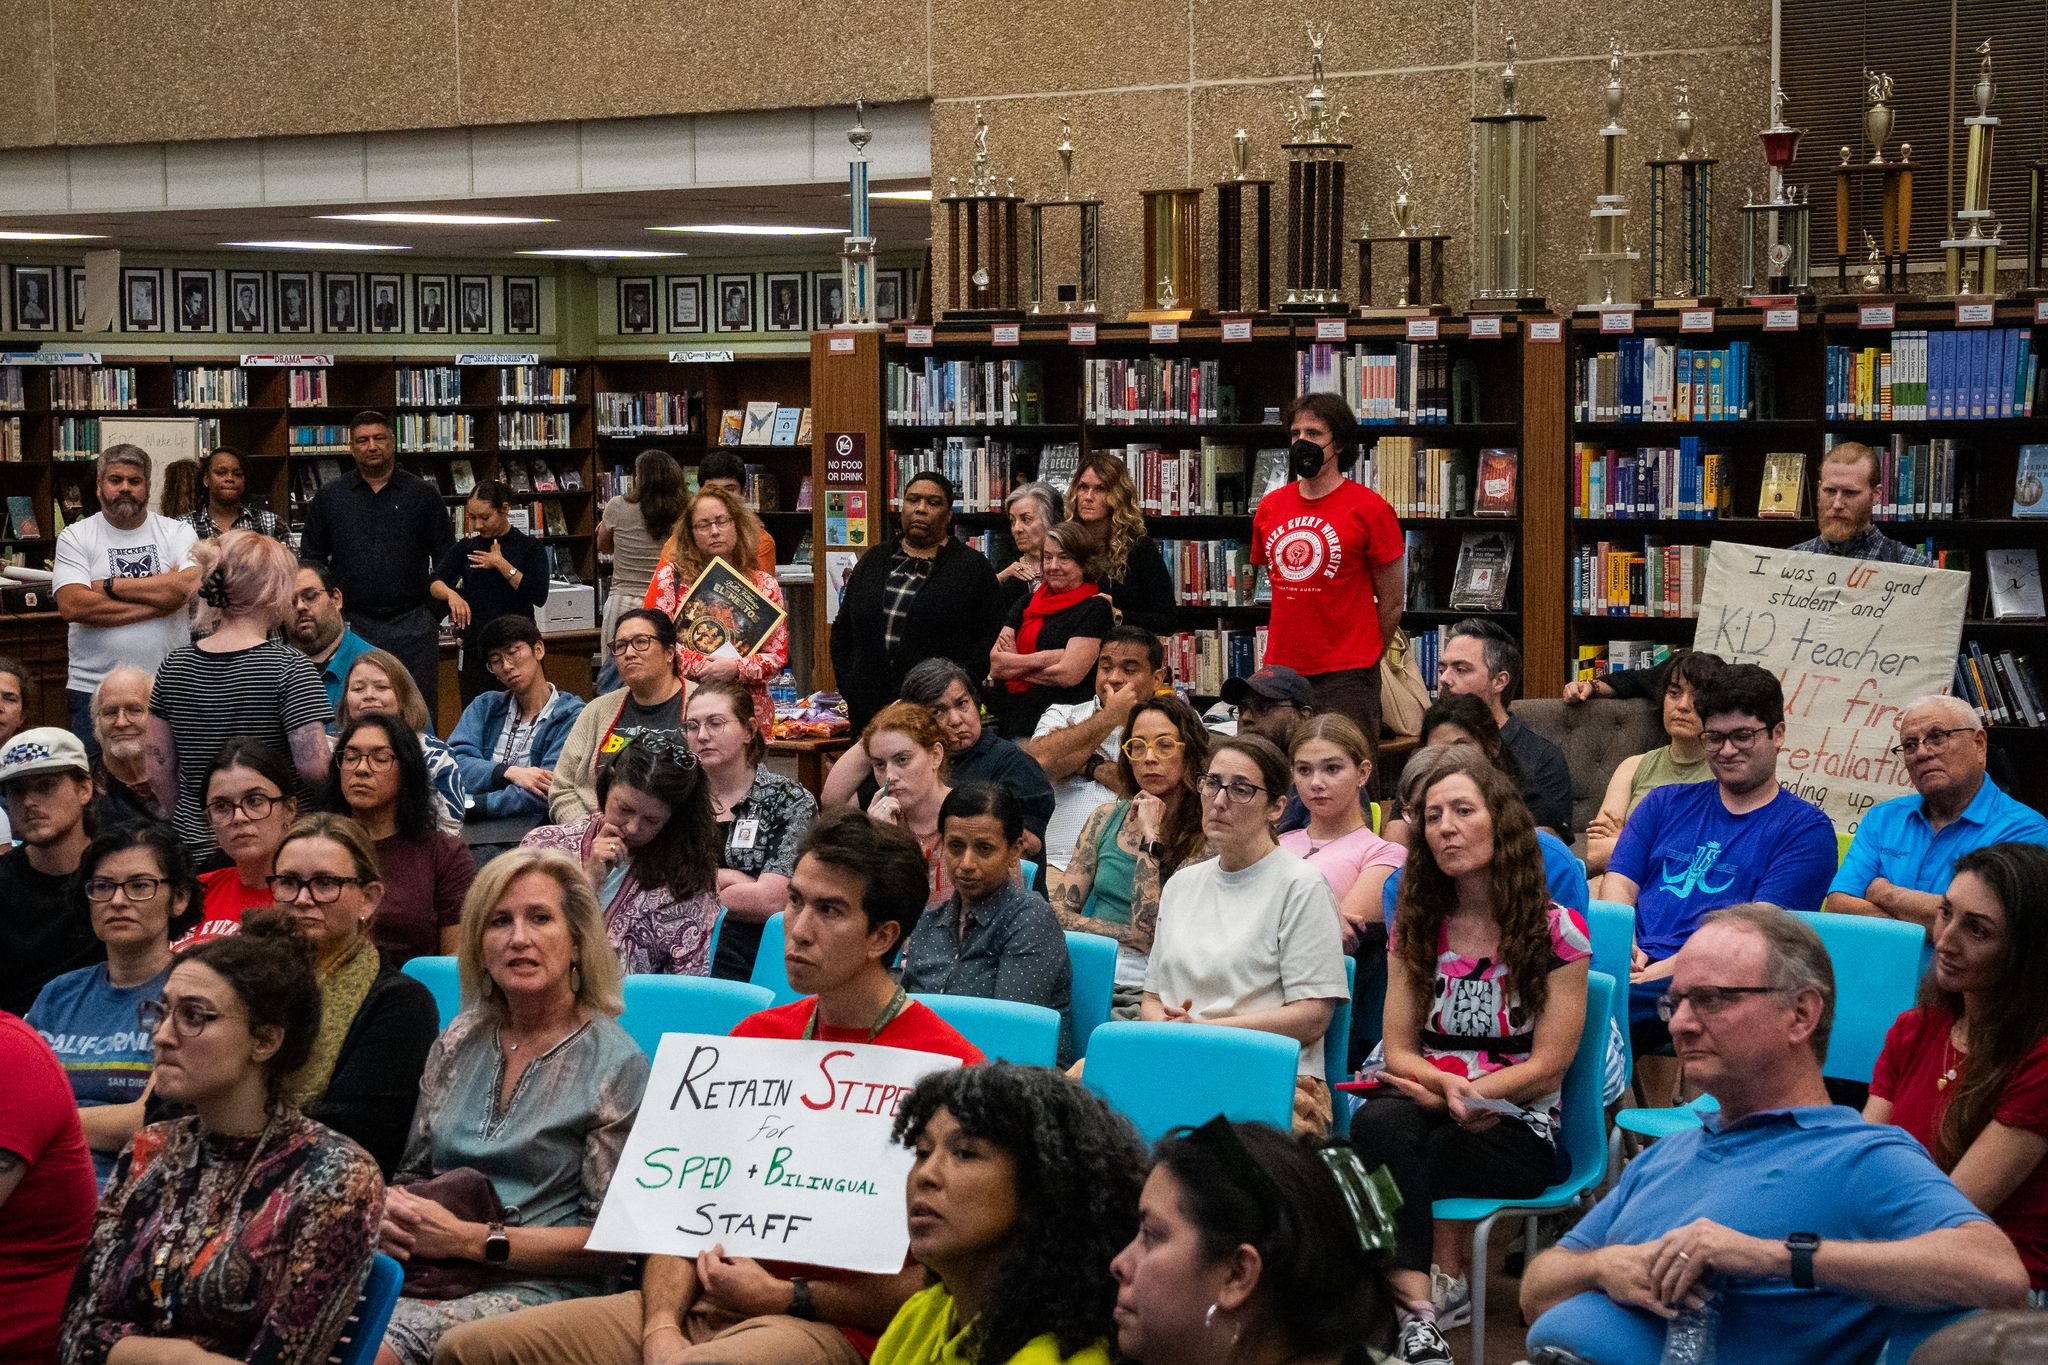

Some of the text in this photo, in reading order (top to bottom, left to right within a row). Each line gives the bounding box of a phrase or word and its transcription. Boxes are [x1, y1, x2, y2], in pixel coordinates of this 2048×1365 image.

[34, 352, 65, 362] POETRY
[274, 354, 301, 364] DRAMA
[474, 353, 521, 363] SHORT STORIES
[828, 460, 863, 470] NO FOOD
[828, 472, 863, 481] OR DRINK
[1050, 457, 1079, 469] DECEIT
[116, 546, 147, 556] BECKER
[1287, 515, 1324, 530] EVERY
[1320, 522, 1342, 579] WORKSITE
[2003, 555, 2023, 568] Joy
[1748, 554, 1928, 602] I was a UT grad
[1768, 584, 1895, 619] student and
[1790, 617, 1920, 677] teacher
[1842, 677, 1911, 732] fire
[1777, 726, 1915, 789] retaliatio
[1779, 772, 1875, 814] nding up
[200, 919, 240, 936] EVER
[38, 1029, 155, 1056] CALIFORNI
[107, 1077, 127, 1087] SAN
[669, 1045, 914, 1117] RETAIN STIPE
[635, 1146, 880, 1196] SPED + BILINGUAL
[676, 1202, 813, 1244] STAFF
